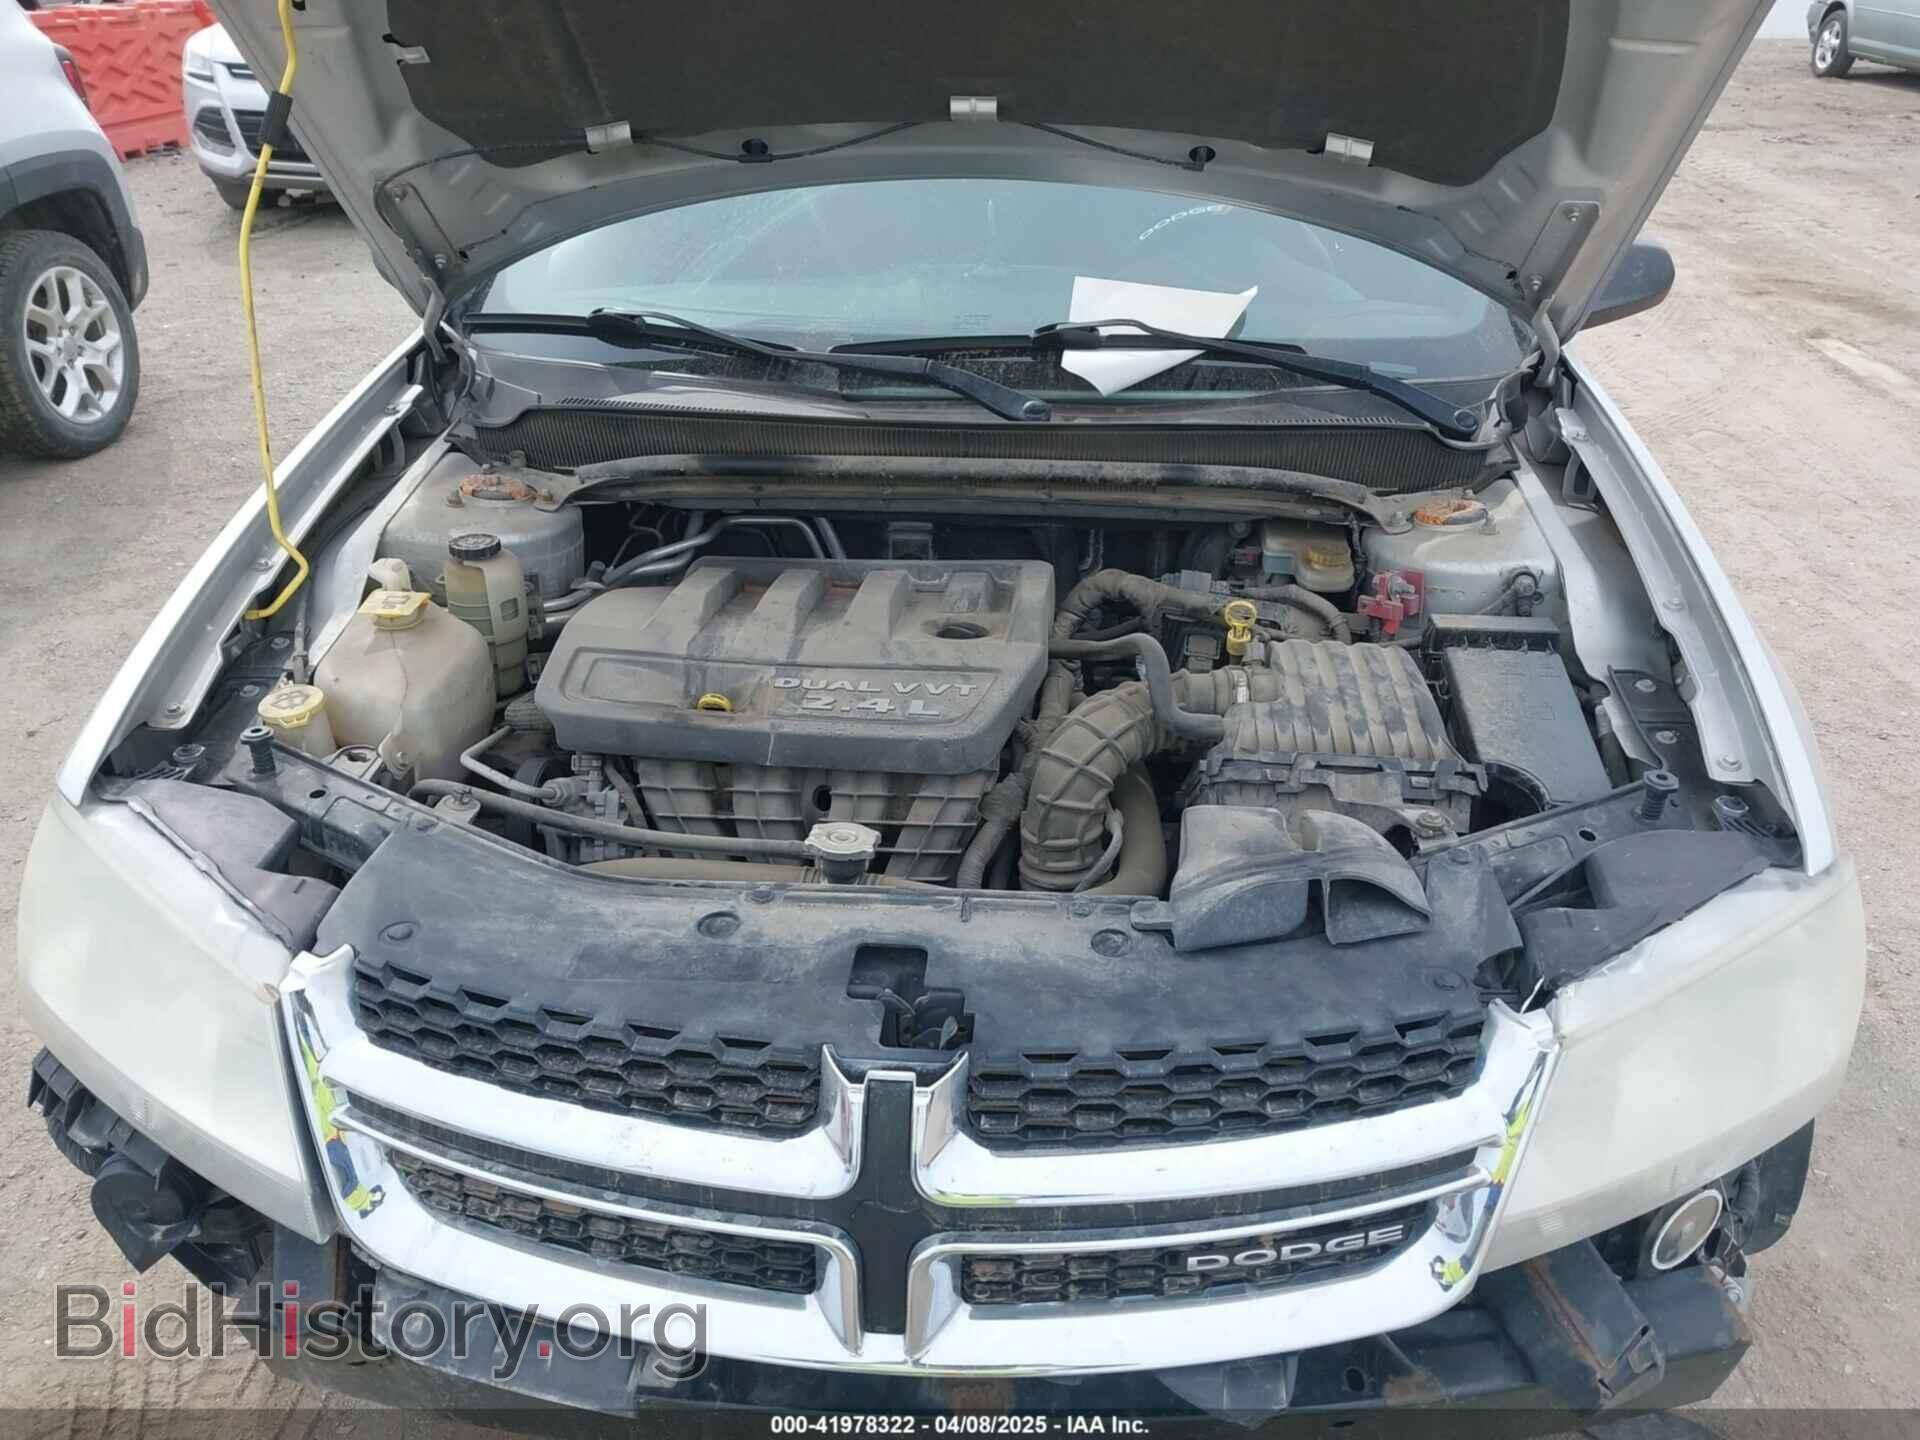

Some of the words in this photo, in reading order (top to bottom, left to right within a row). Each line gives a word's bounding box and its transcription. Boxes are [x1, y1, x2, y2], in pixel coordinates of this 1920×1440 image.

[773, 677, 881, 693] DUAL
[893, 681, 977, 697] VVT
[1187, 1224, 1404, 1272] DODGE
